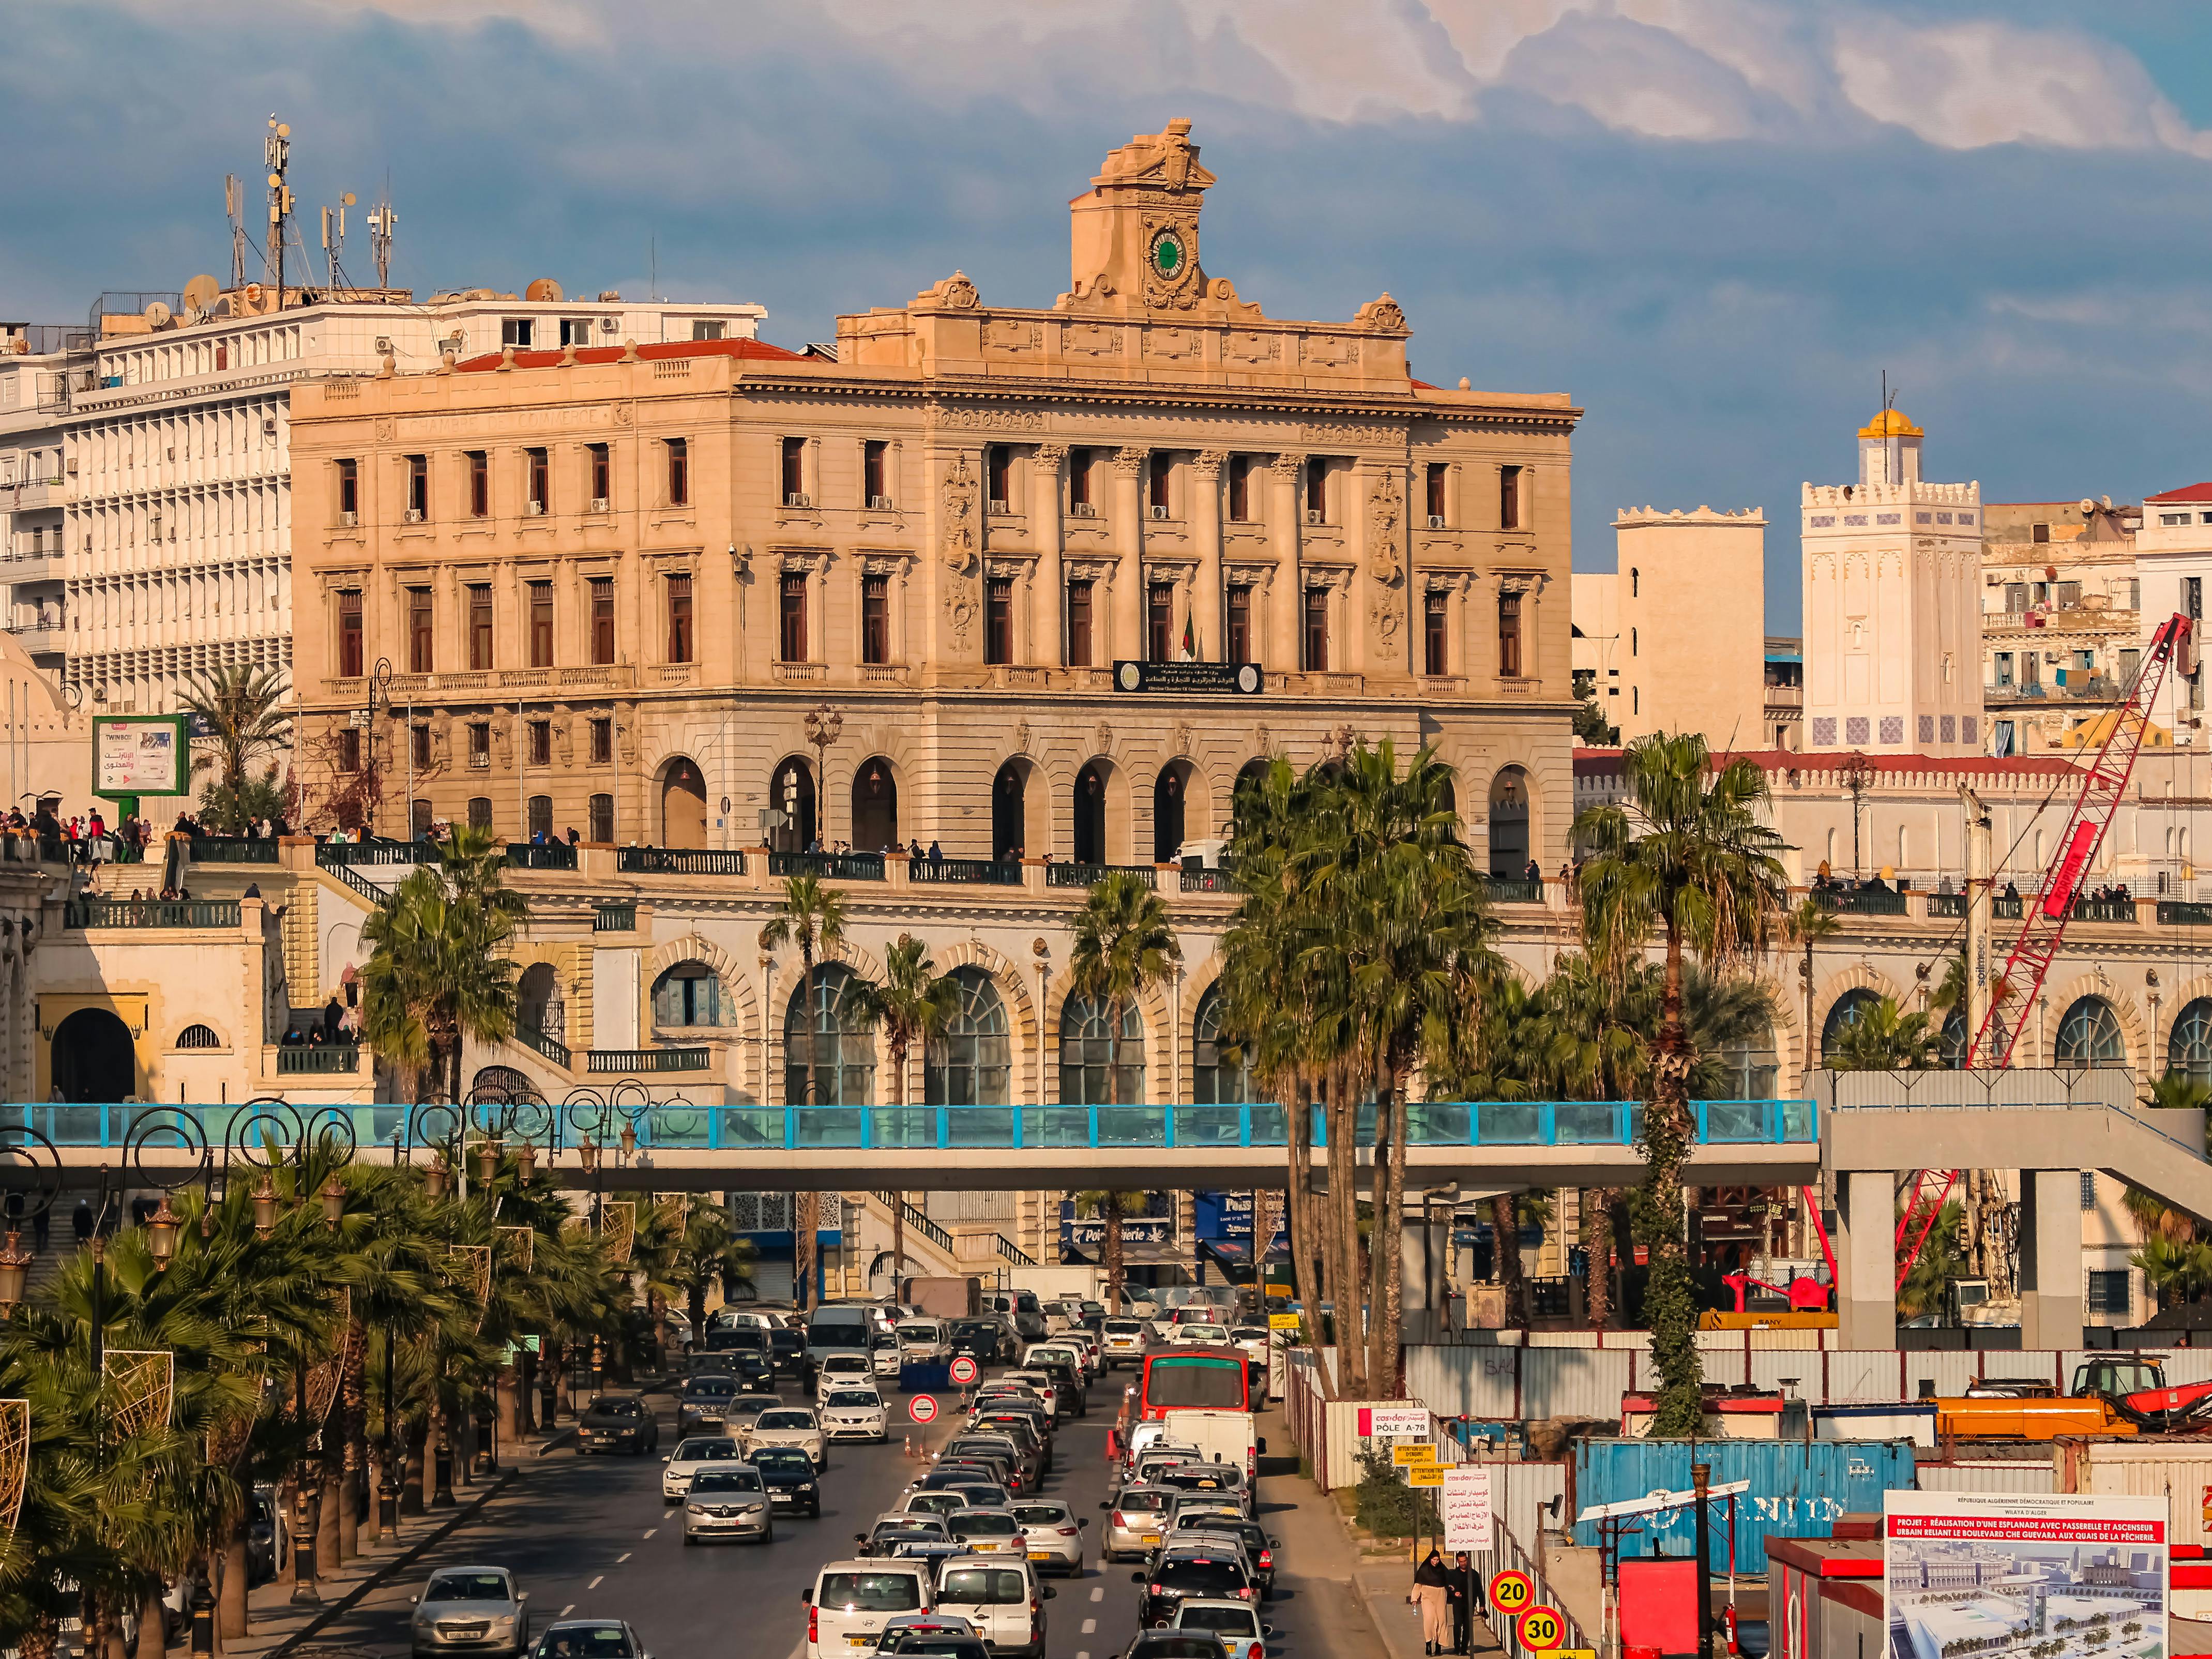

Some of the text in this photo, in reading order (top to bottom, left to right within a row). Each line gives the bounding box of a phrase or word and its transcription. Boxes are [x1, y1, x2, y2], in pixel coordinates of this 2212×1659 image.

[2054, 854, 2085, 899] FORPIEUX
[1376, 1423, 1400, 1432] PÔLE
[1930, 1518, 1975, 1527] RÉALISATION
[2121, 1532, 2156, 1541] PÊCHERIE.
[1500, 1583, 1525, 1601] 20
[1528, 1620, 1555, 1639] 30
